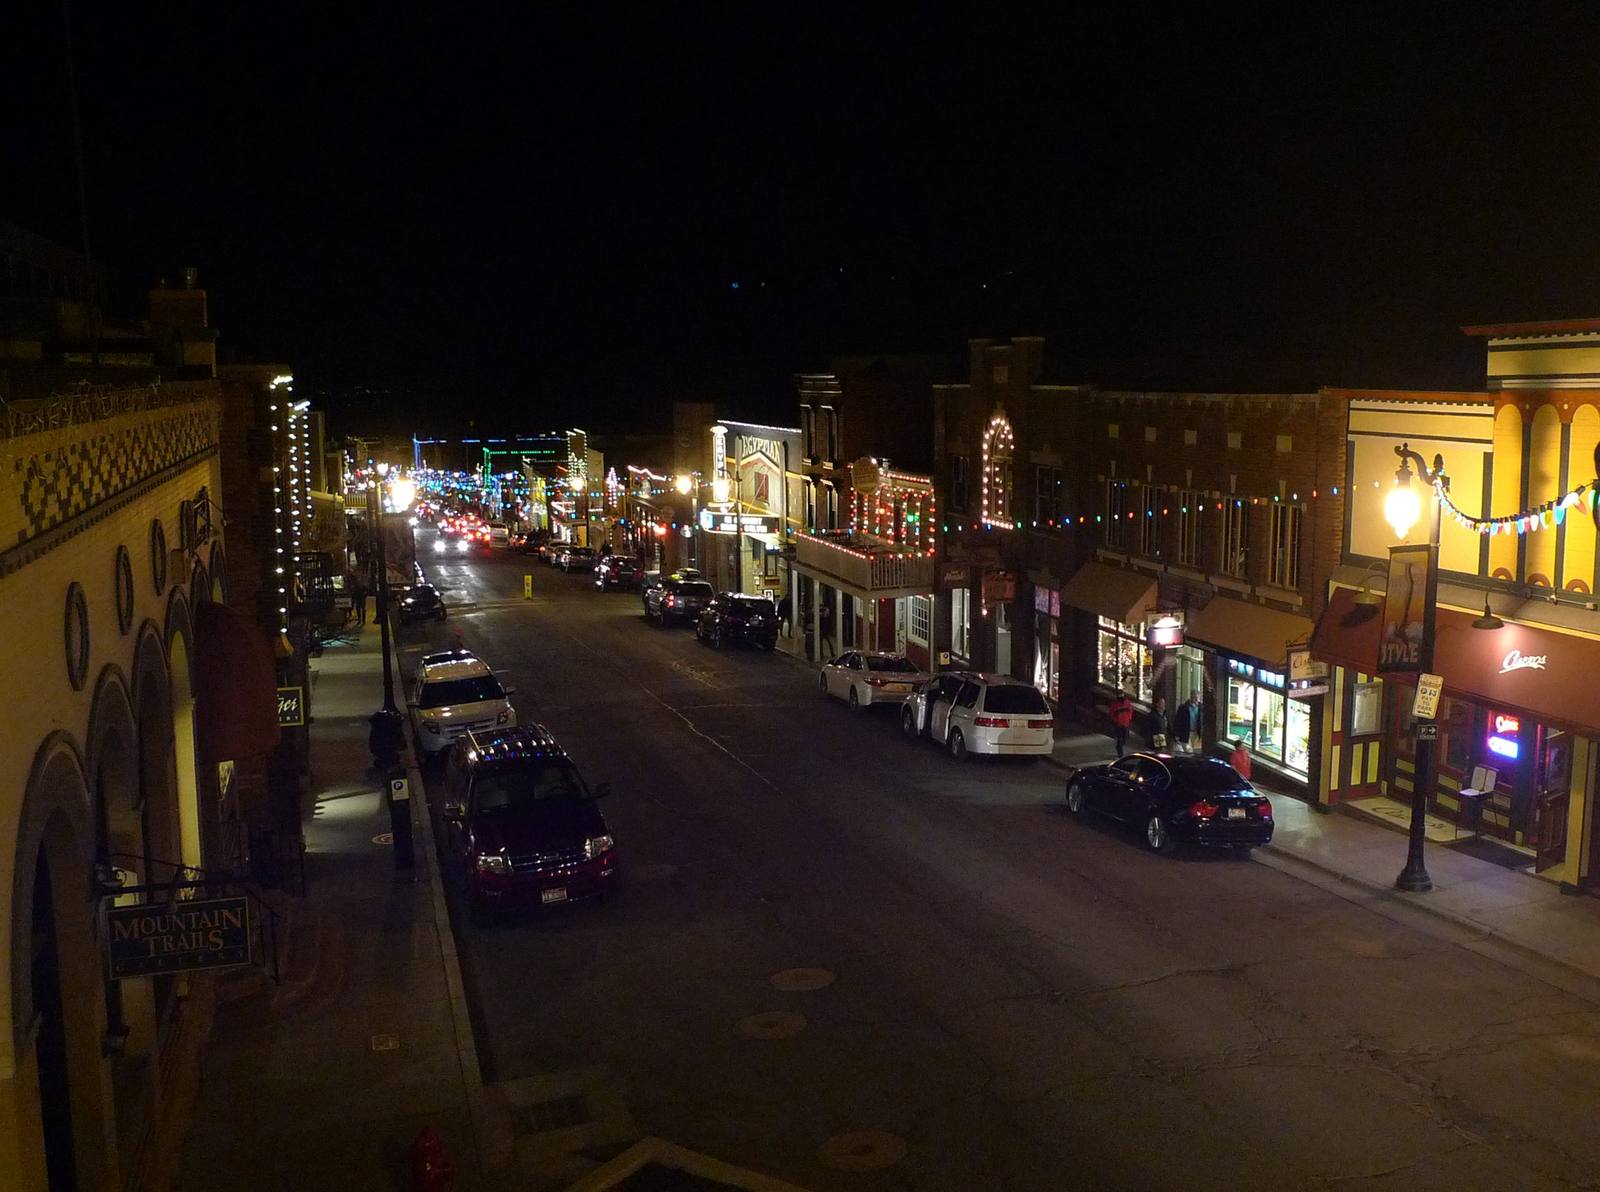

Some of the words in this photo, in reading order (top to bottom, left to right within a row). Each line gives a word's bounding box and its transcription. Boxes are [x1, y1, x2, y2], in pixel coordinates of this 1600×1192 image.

[742, 435, 781, 463] EGYPTIAN
[1381, 642, 1418, 664] STYLE
[112, 908, 242, 940] MOUNTAIN
[144, 930, 225, 957] TRAILS
